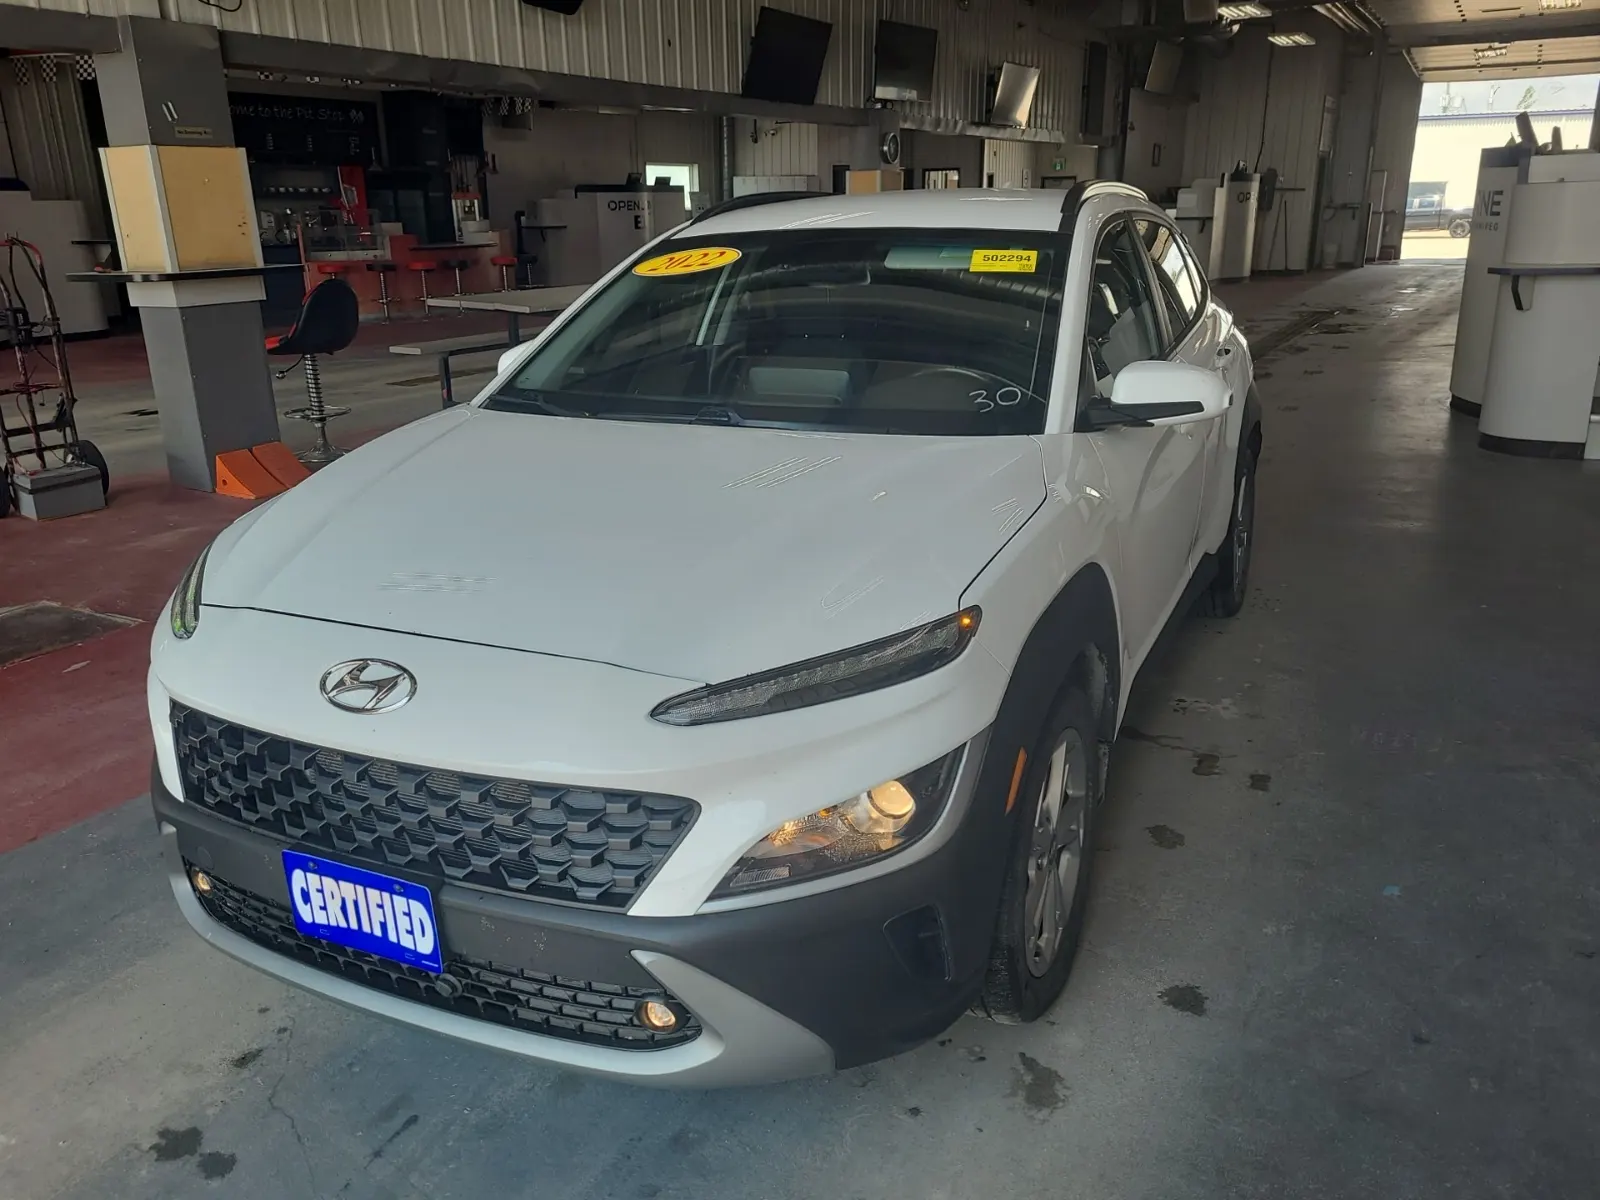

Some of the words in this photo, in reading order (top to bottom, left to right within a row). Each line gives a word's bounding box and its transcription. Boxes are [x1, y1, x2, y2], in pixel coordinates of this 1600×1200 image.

[645, 251, 727, 272] 2022
[982, 254, 1032, 262] 502294
[968, 387, 1021, 412] 30
[291, 868, 435, 955] CERTIFIED
